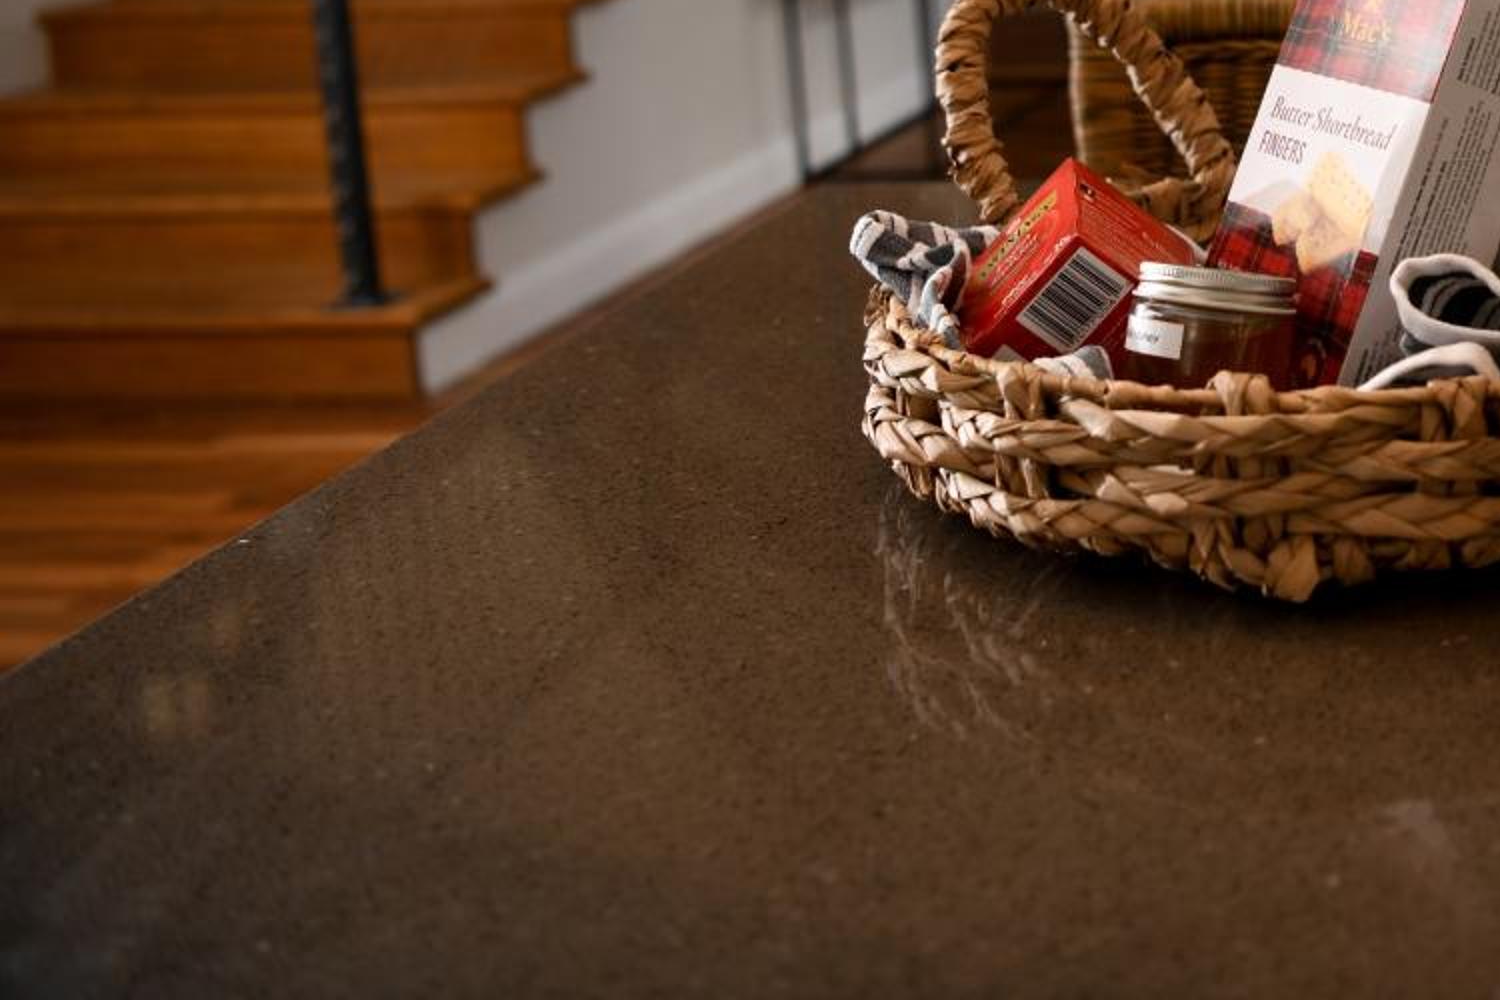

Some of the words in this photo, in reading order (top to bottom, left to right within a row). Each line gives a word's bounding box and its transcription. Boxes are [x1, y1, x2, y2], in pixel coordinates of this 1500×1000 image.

[1270, 95, 1313, 126] Butter
[1312, 107, 1398, 151] Shortbread
[1257, 130, 1307, 165] FINGERS
